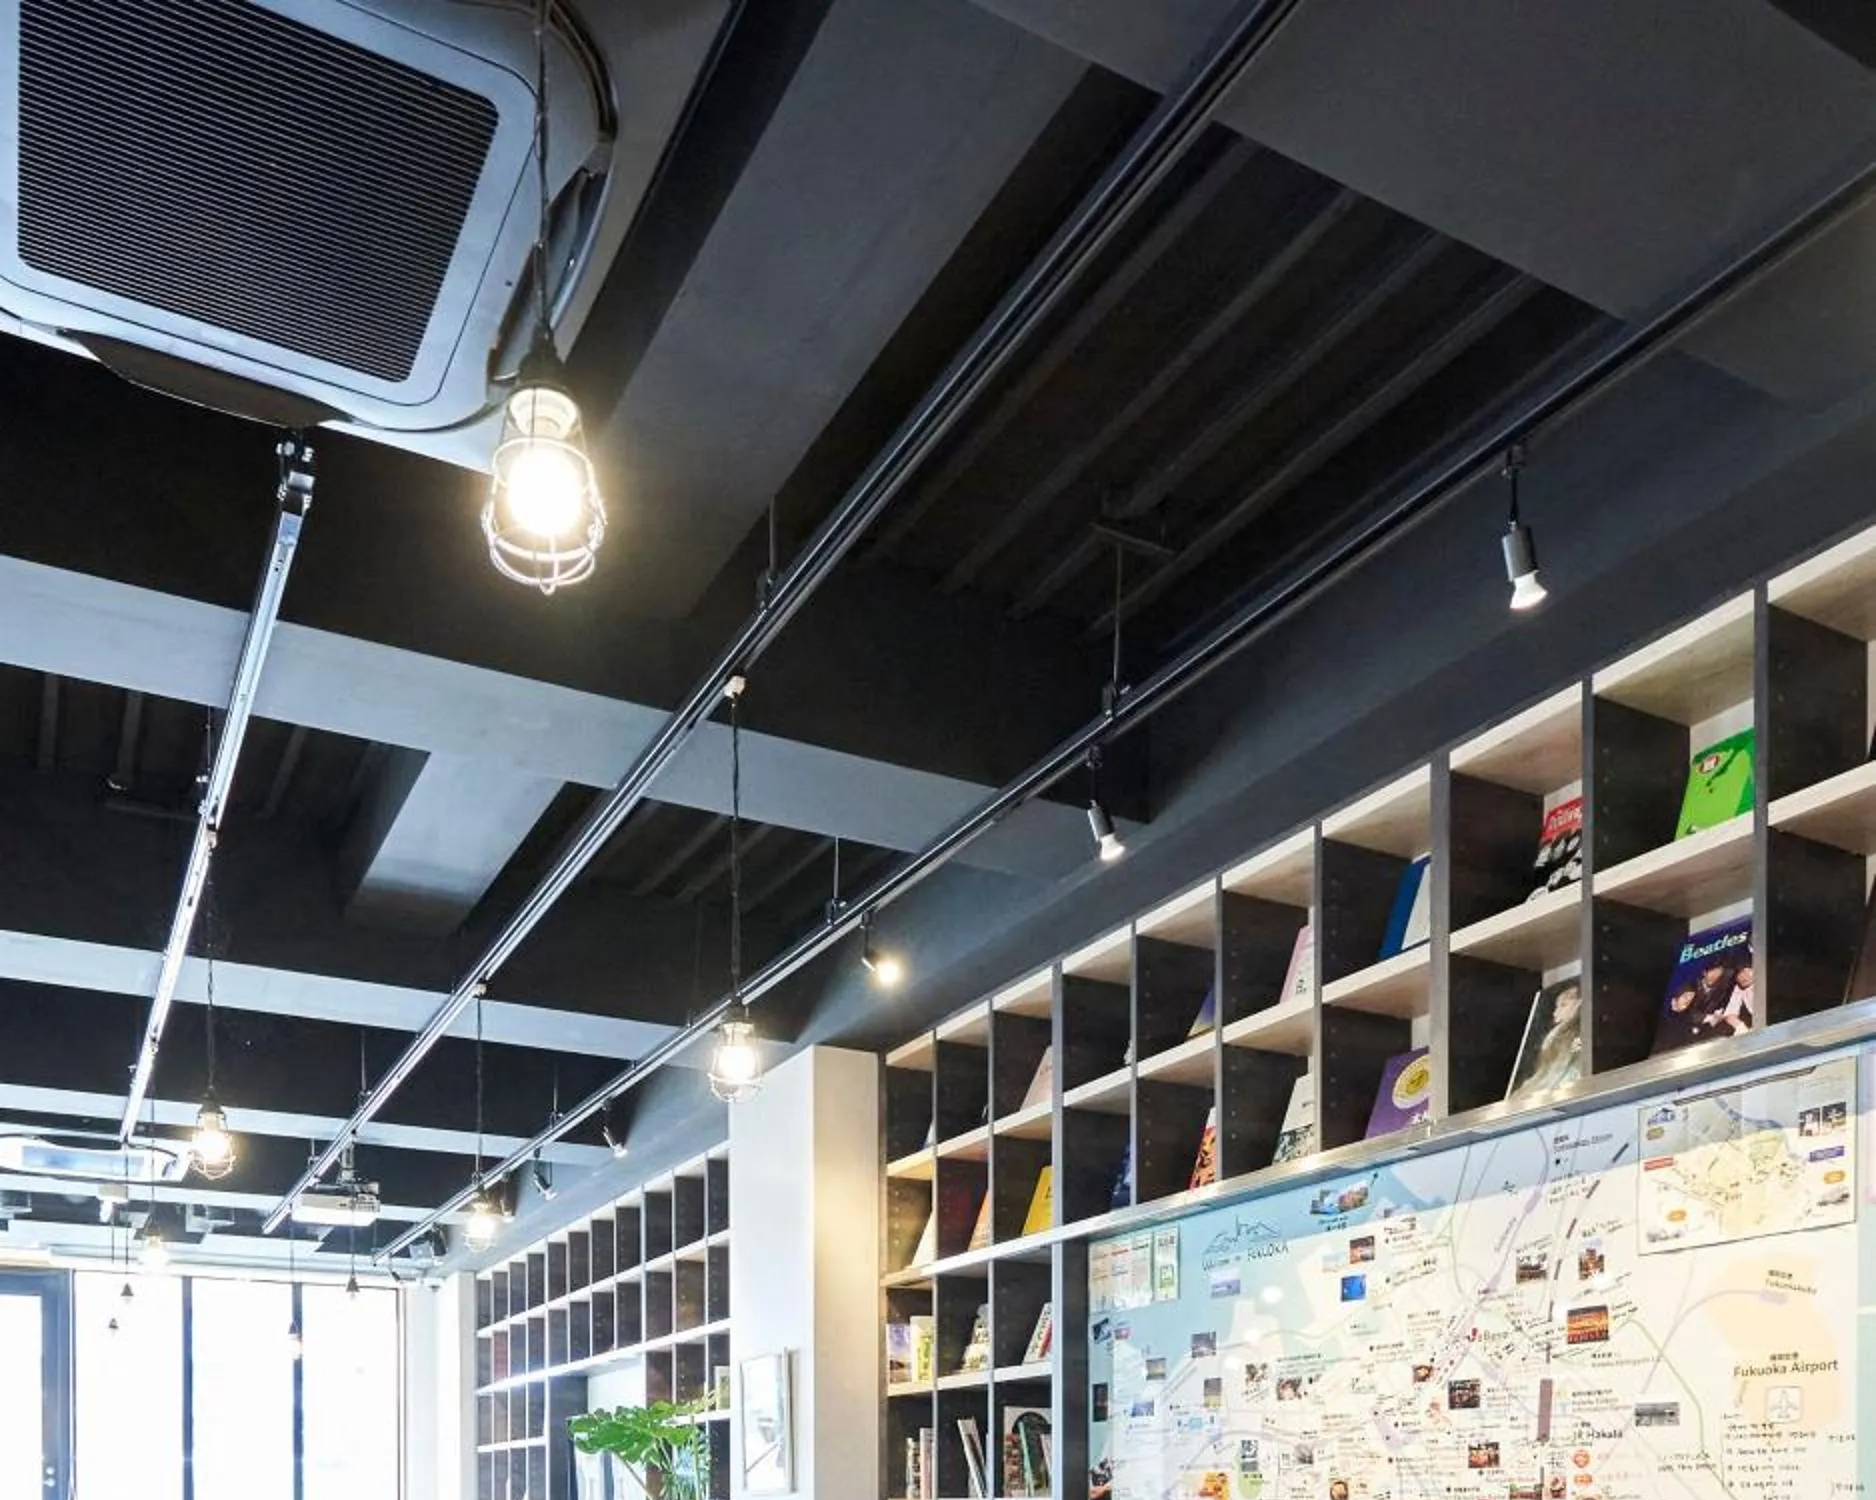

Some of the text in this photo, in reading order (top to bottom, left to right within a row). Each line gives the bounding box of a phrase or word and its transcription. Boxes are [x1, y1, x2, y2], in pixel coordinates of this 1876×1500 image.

[1680, 932, 1749, 964] Beatles
[1733, 1359, 1838, 1377] Fukuoka Airport
